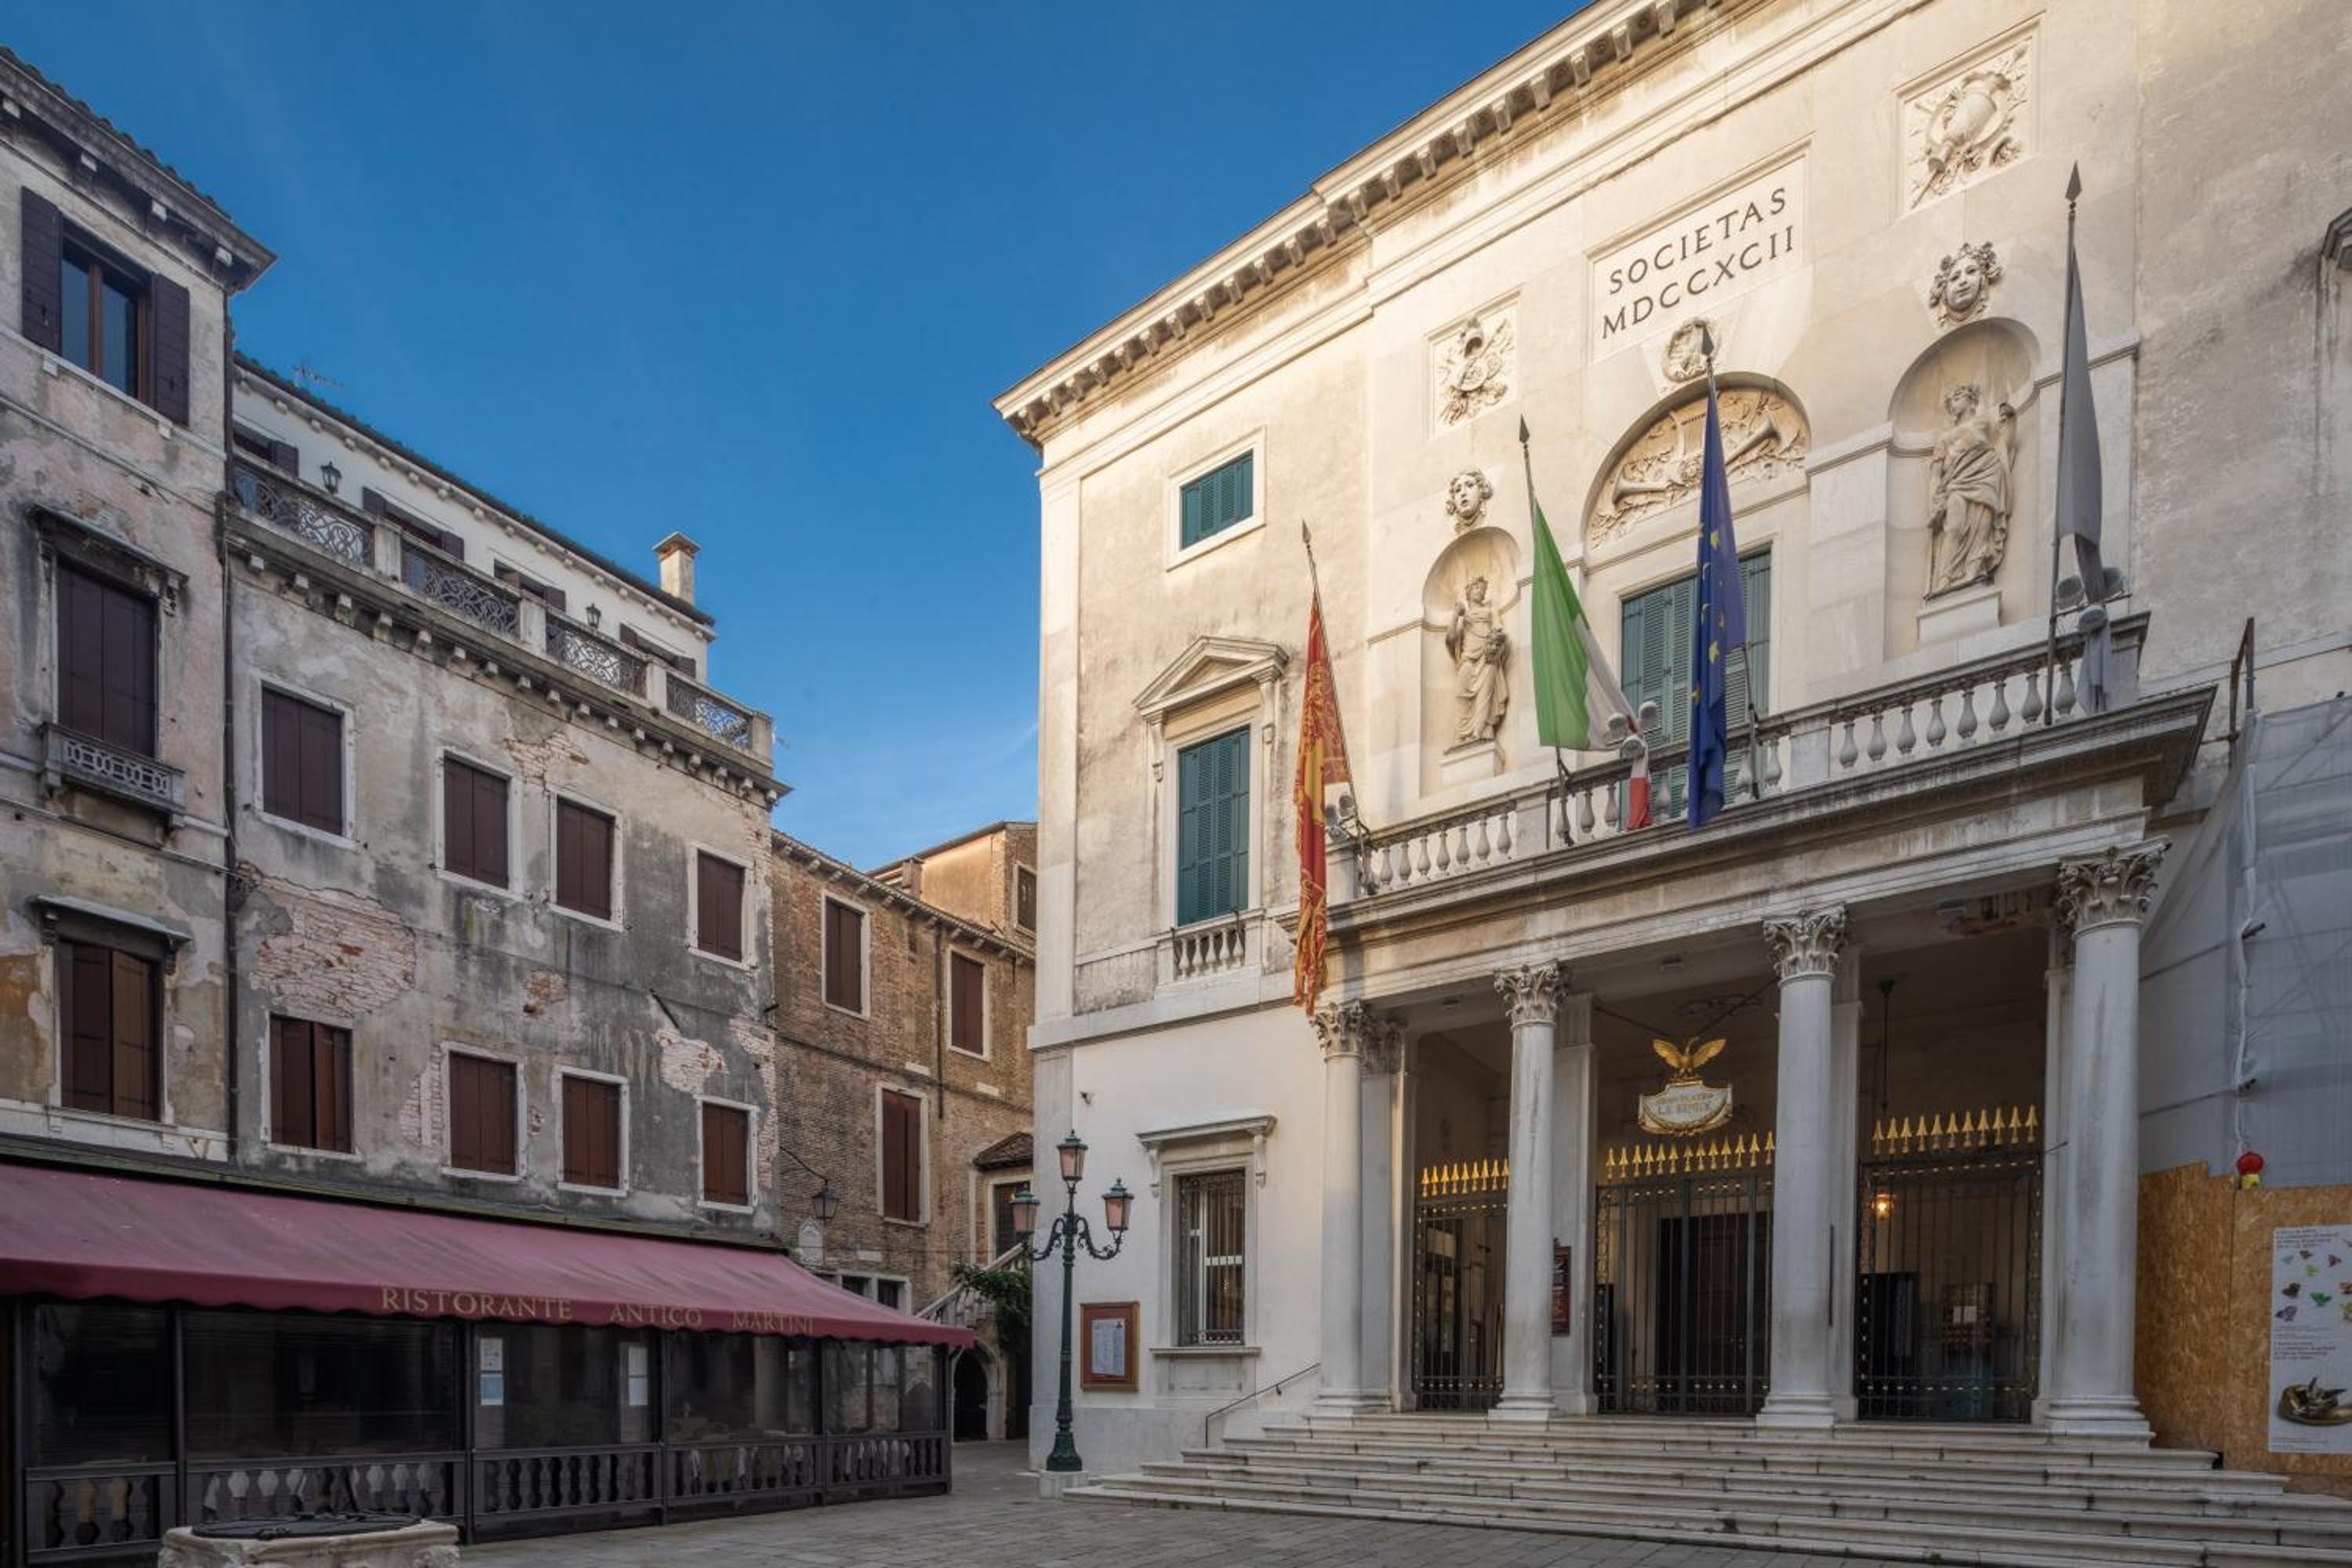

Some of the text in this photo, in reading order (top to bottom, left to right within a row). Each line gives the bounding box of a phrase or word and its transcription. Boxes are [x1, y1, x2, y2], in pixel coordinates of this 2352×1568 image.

[1602, 225, 1794, 339] MDCCXCII
[1609, 187, 1786, 295] SOCIETAS
[382, 1287, 815, 1334] RISTORANTE ANTICO MARTINI
